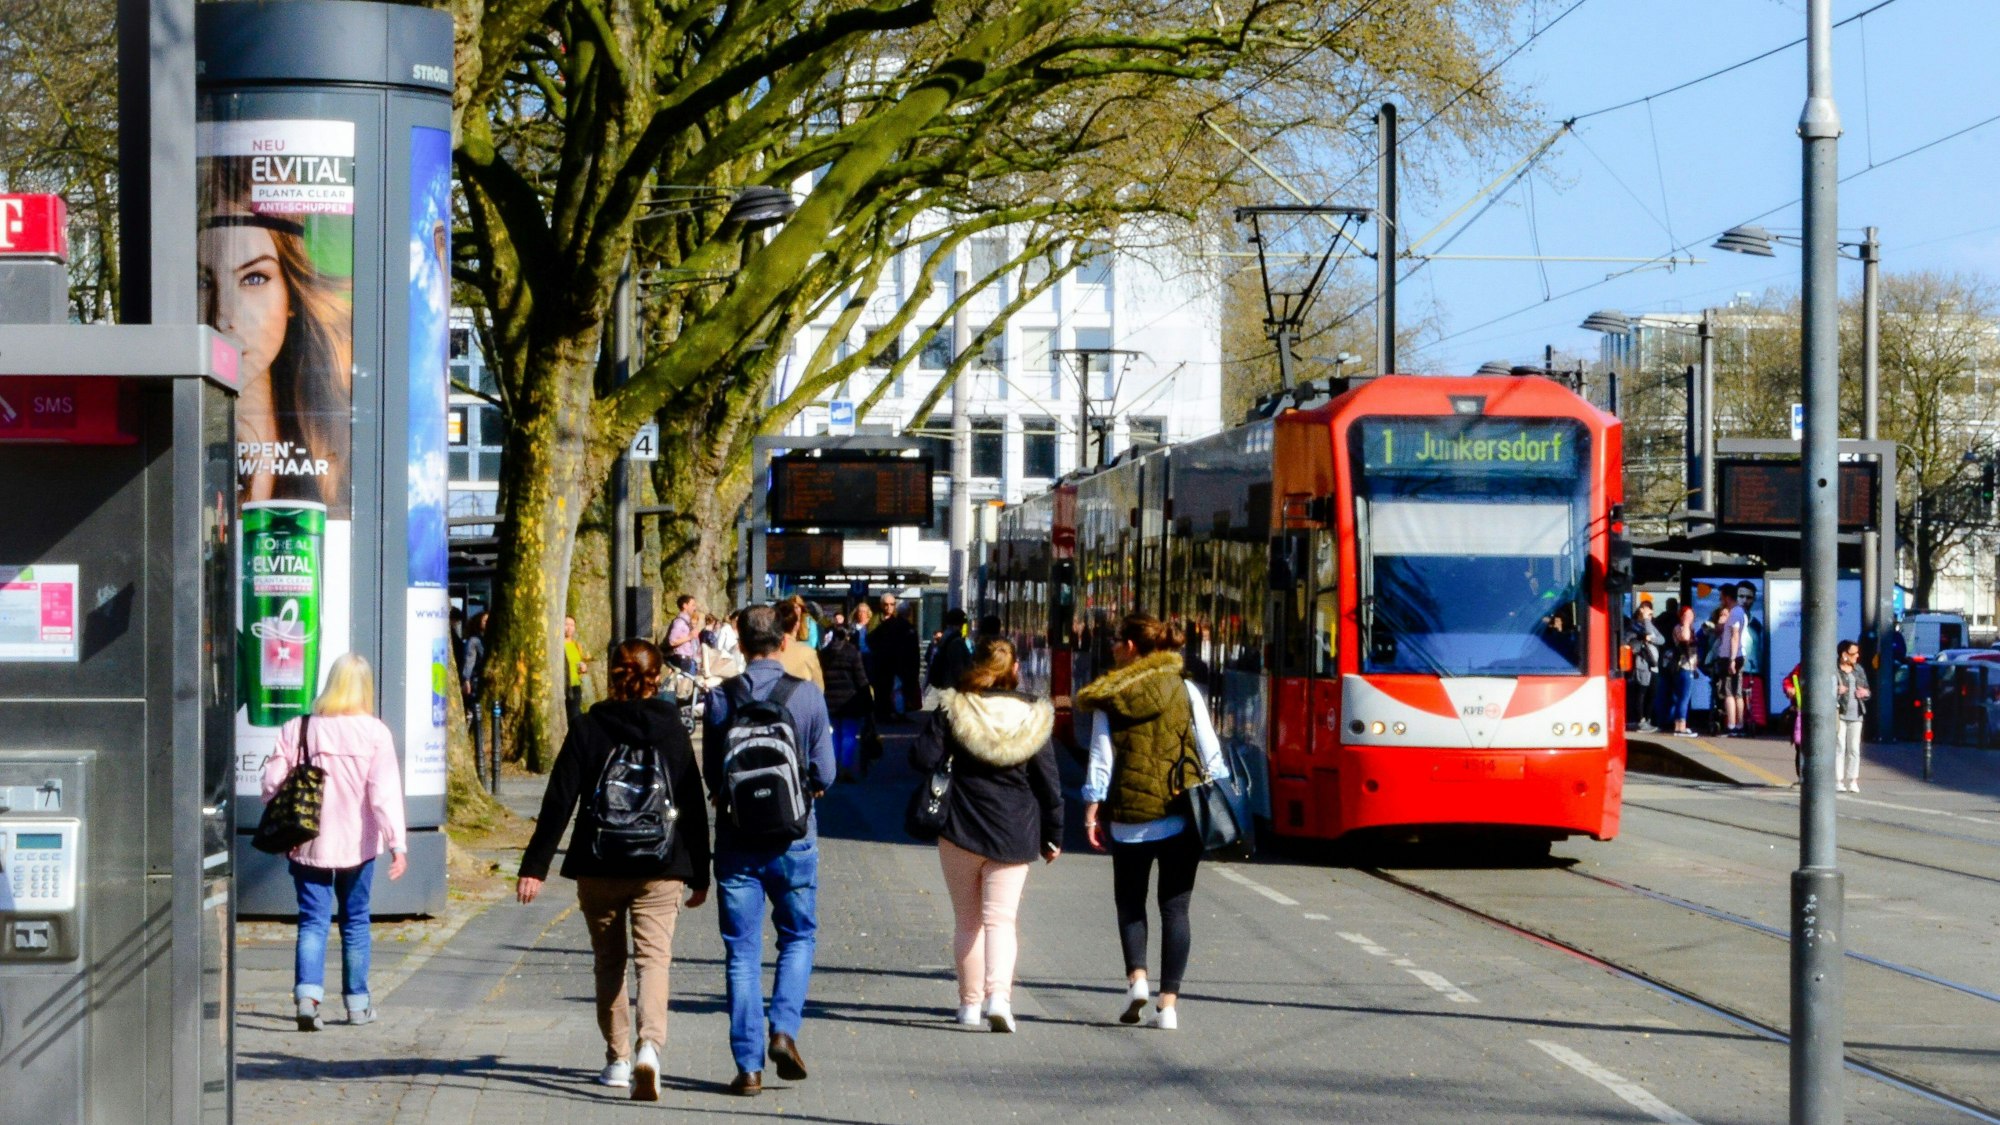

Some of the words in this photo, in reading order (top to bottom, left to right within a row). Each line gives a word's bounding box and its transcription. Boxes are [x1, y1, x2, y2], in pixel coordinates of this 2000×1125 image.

[252, 139, 285, 151] NEU
[251, 156, 347, 183] ELVITAL
[259, 189, 303, 198] PLANTA
[308, 189, 346, 198] CLEAR
[258, 202, 347, 212] ANTI-SCHUPPEN
[33, 396, 73, 413] SMS
[636, 435, 653, 455] 4
[1382, 429, 1393, 464] 1
[1416, 431, 1562, 462] Junkersdorf
[253, 554, 312, 573] ELVITAL
[1463, 705, 1485, 715] KVB
